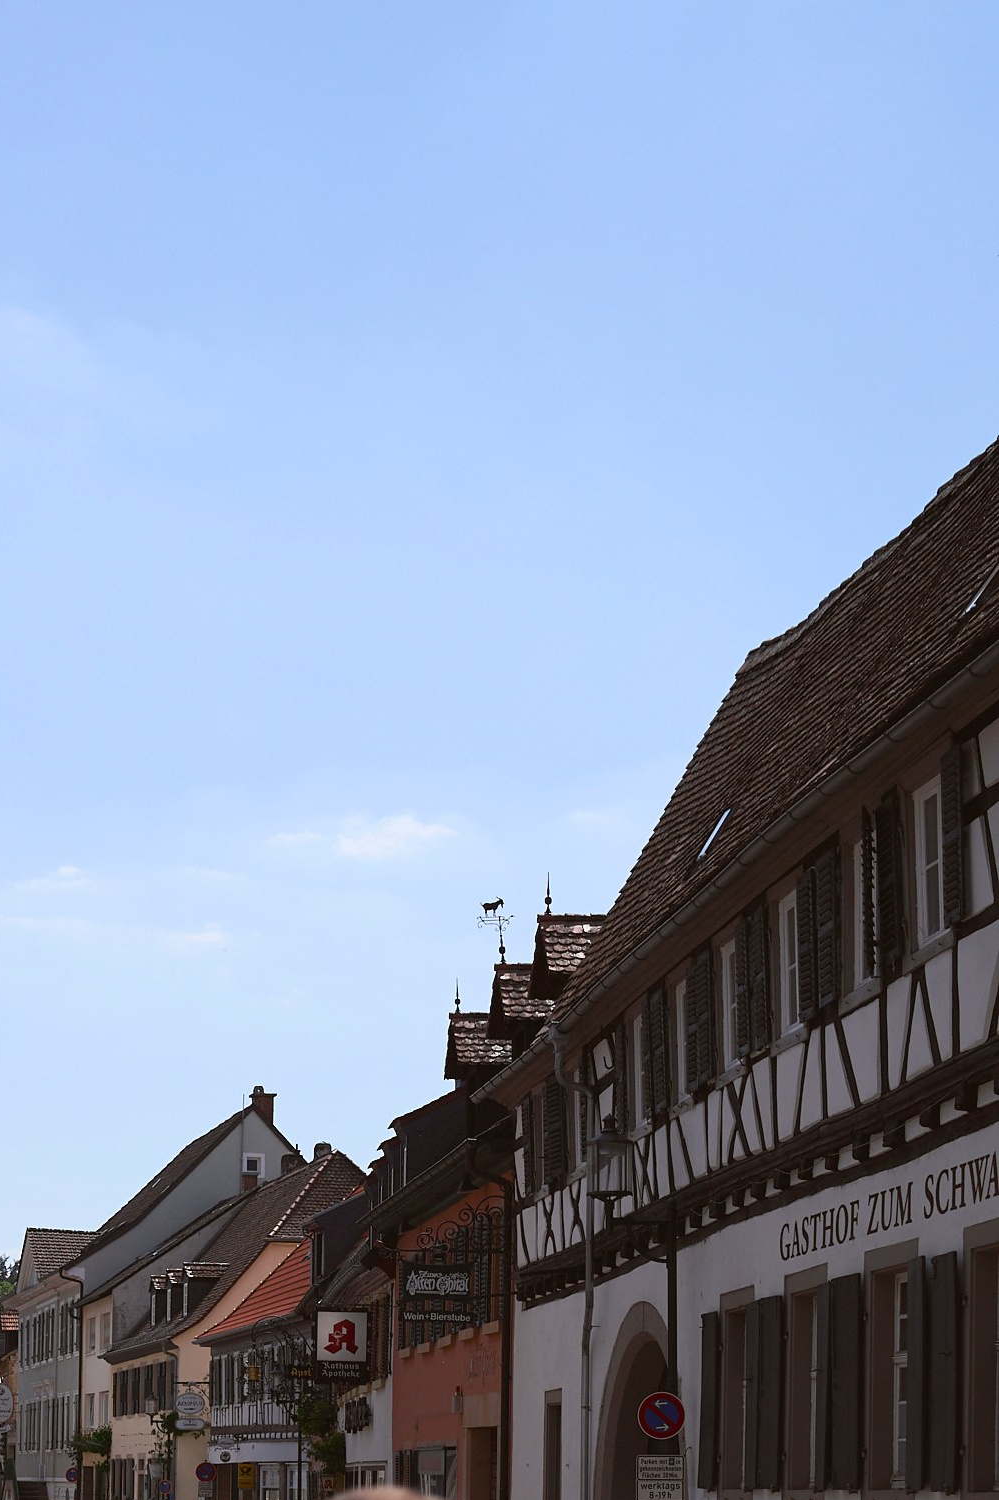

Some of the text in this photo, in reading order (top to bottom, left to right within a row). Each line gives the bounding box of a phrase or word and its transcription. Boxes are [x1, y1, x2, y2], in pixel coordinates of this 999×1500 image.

[779, 1150, 999, 1261] GASTHOF ZUM SCHWA
[403, 1312, 471, 1322] Wein+Bierstube
[321, 1362, 360, 1370] Rathaus
[321, 1369, 360, 1378] Apotheke
[640, 1482, 681, 1491] werktags
[649, 1491, 666, 1499] 8-19
